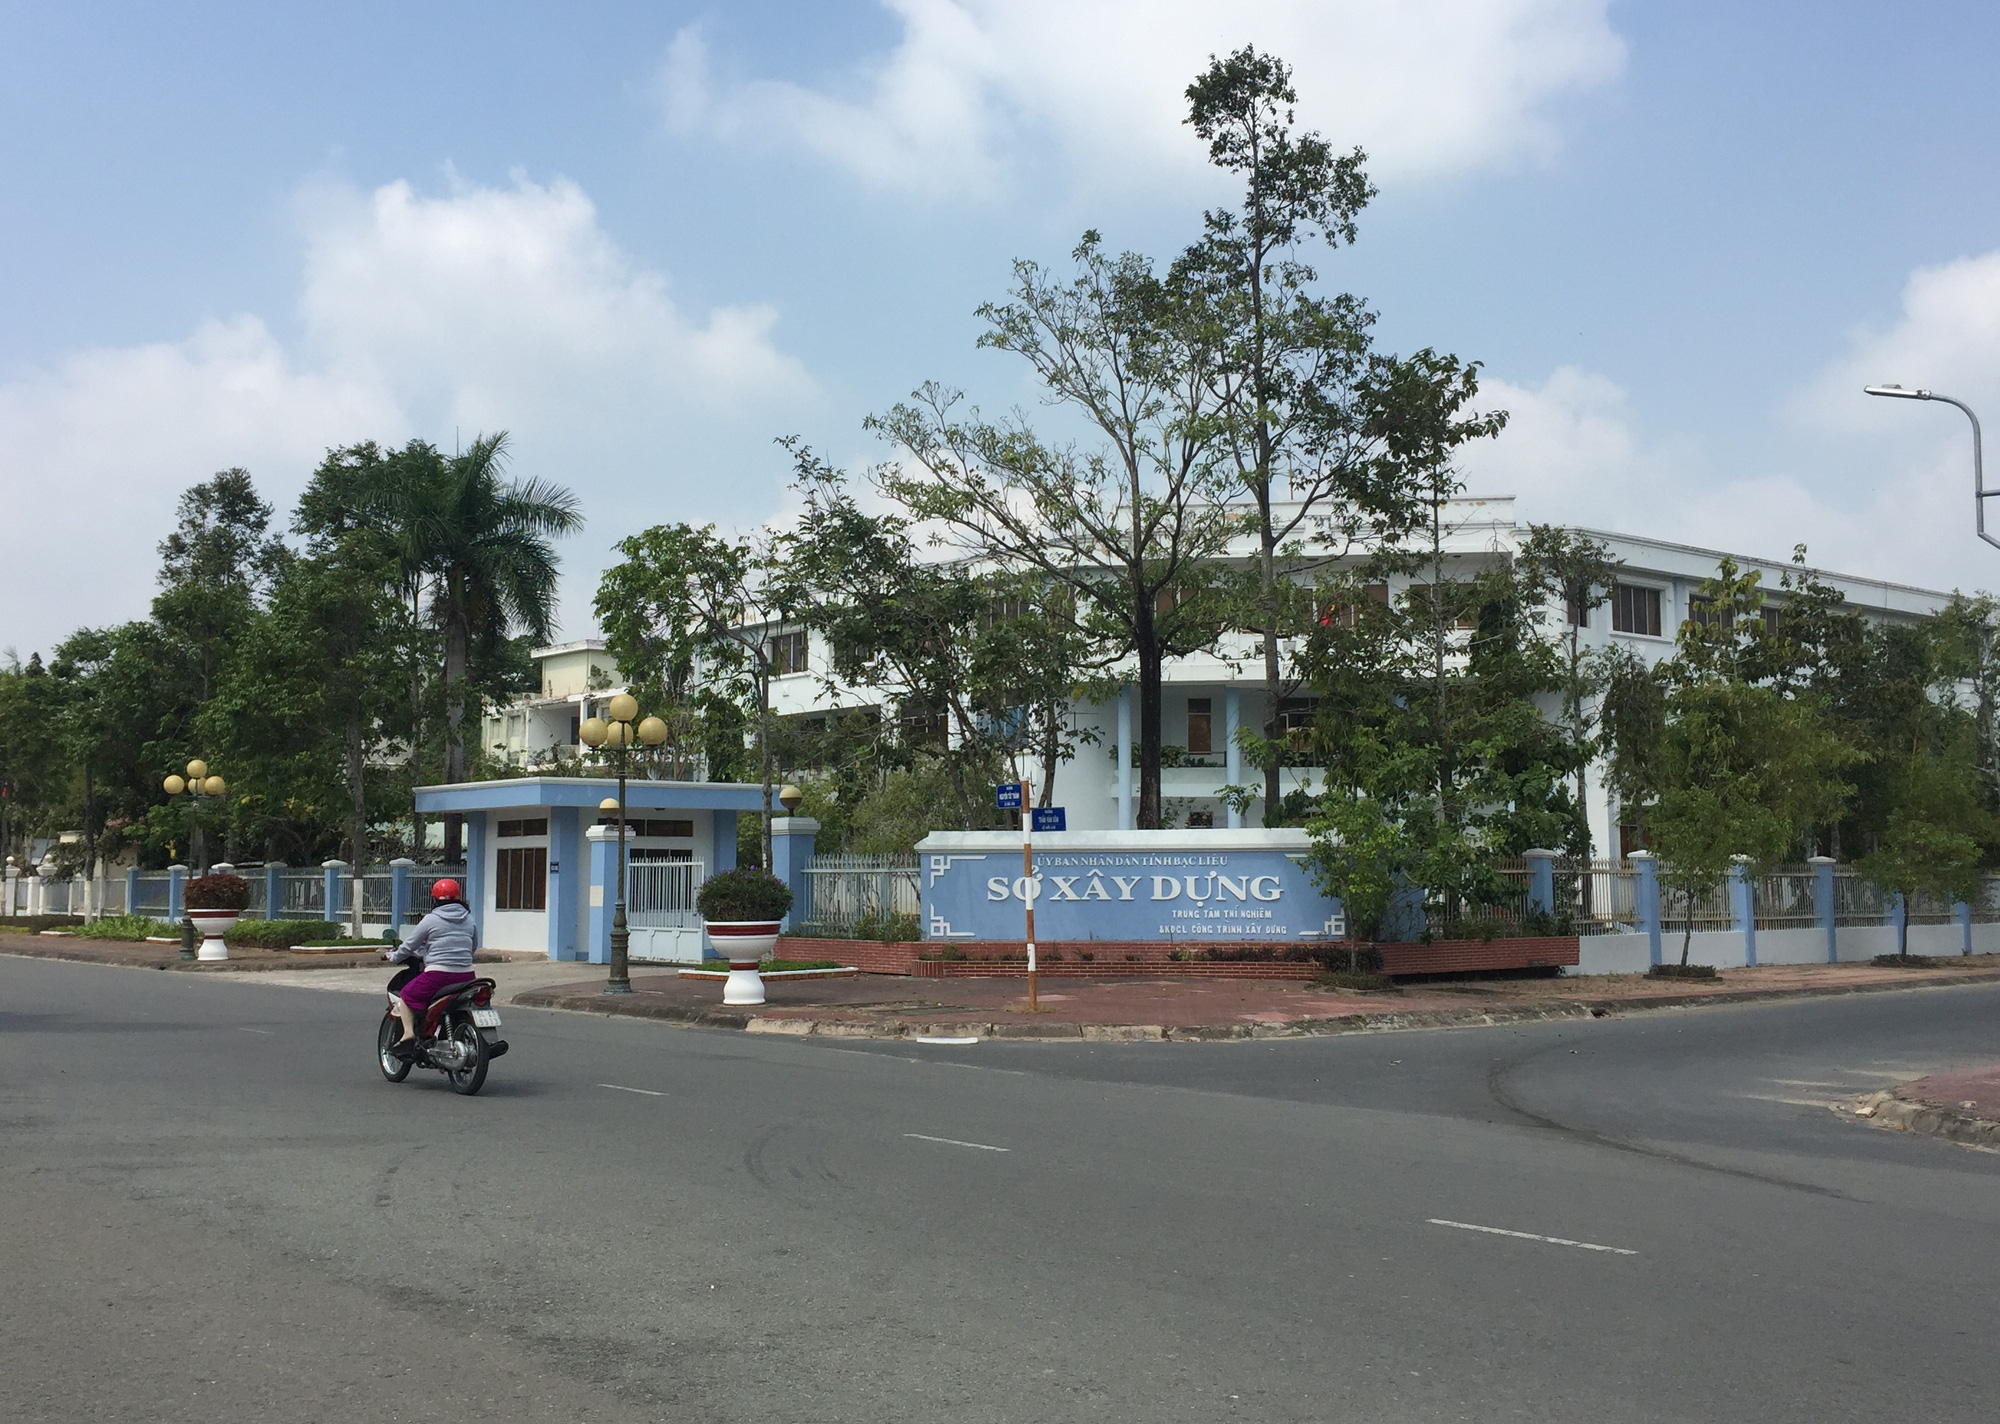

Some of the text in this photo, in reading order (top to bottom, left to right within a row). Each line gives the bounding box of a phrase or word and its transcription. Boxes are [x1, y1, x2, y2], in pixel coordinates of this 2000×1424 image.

[1054, 857, 1079, 866] BAN
[1080, 854, 1114, 866] NHÂN
[1115, 854, 1139, 866] DÂN
[1173, 856, 1197, 868] BẠC
[1198, 853, 1228, 866] LIÊU
[987, 865, 1285, 908] SỞ XÂY DỰNG
[1172, 909, 1200, 919] TRUNG
[1203, 907, 1221, 919] TÂM
[1223, 904, 1239, 919] THÍ
[1191, 922, 1213, 934] CÔNG
[1216, 920, 1242, 934] TRÌNH
[1245, 922, 1262, 934] XÂY
